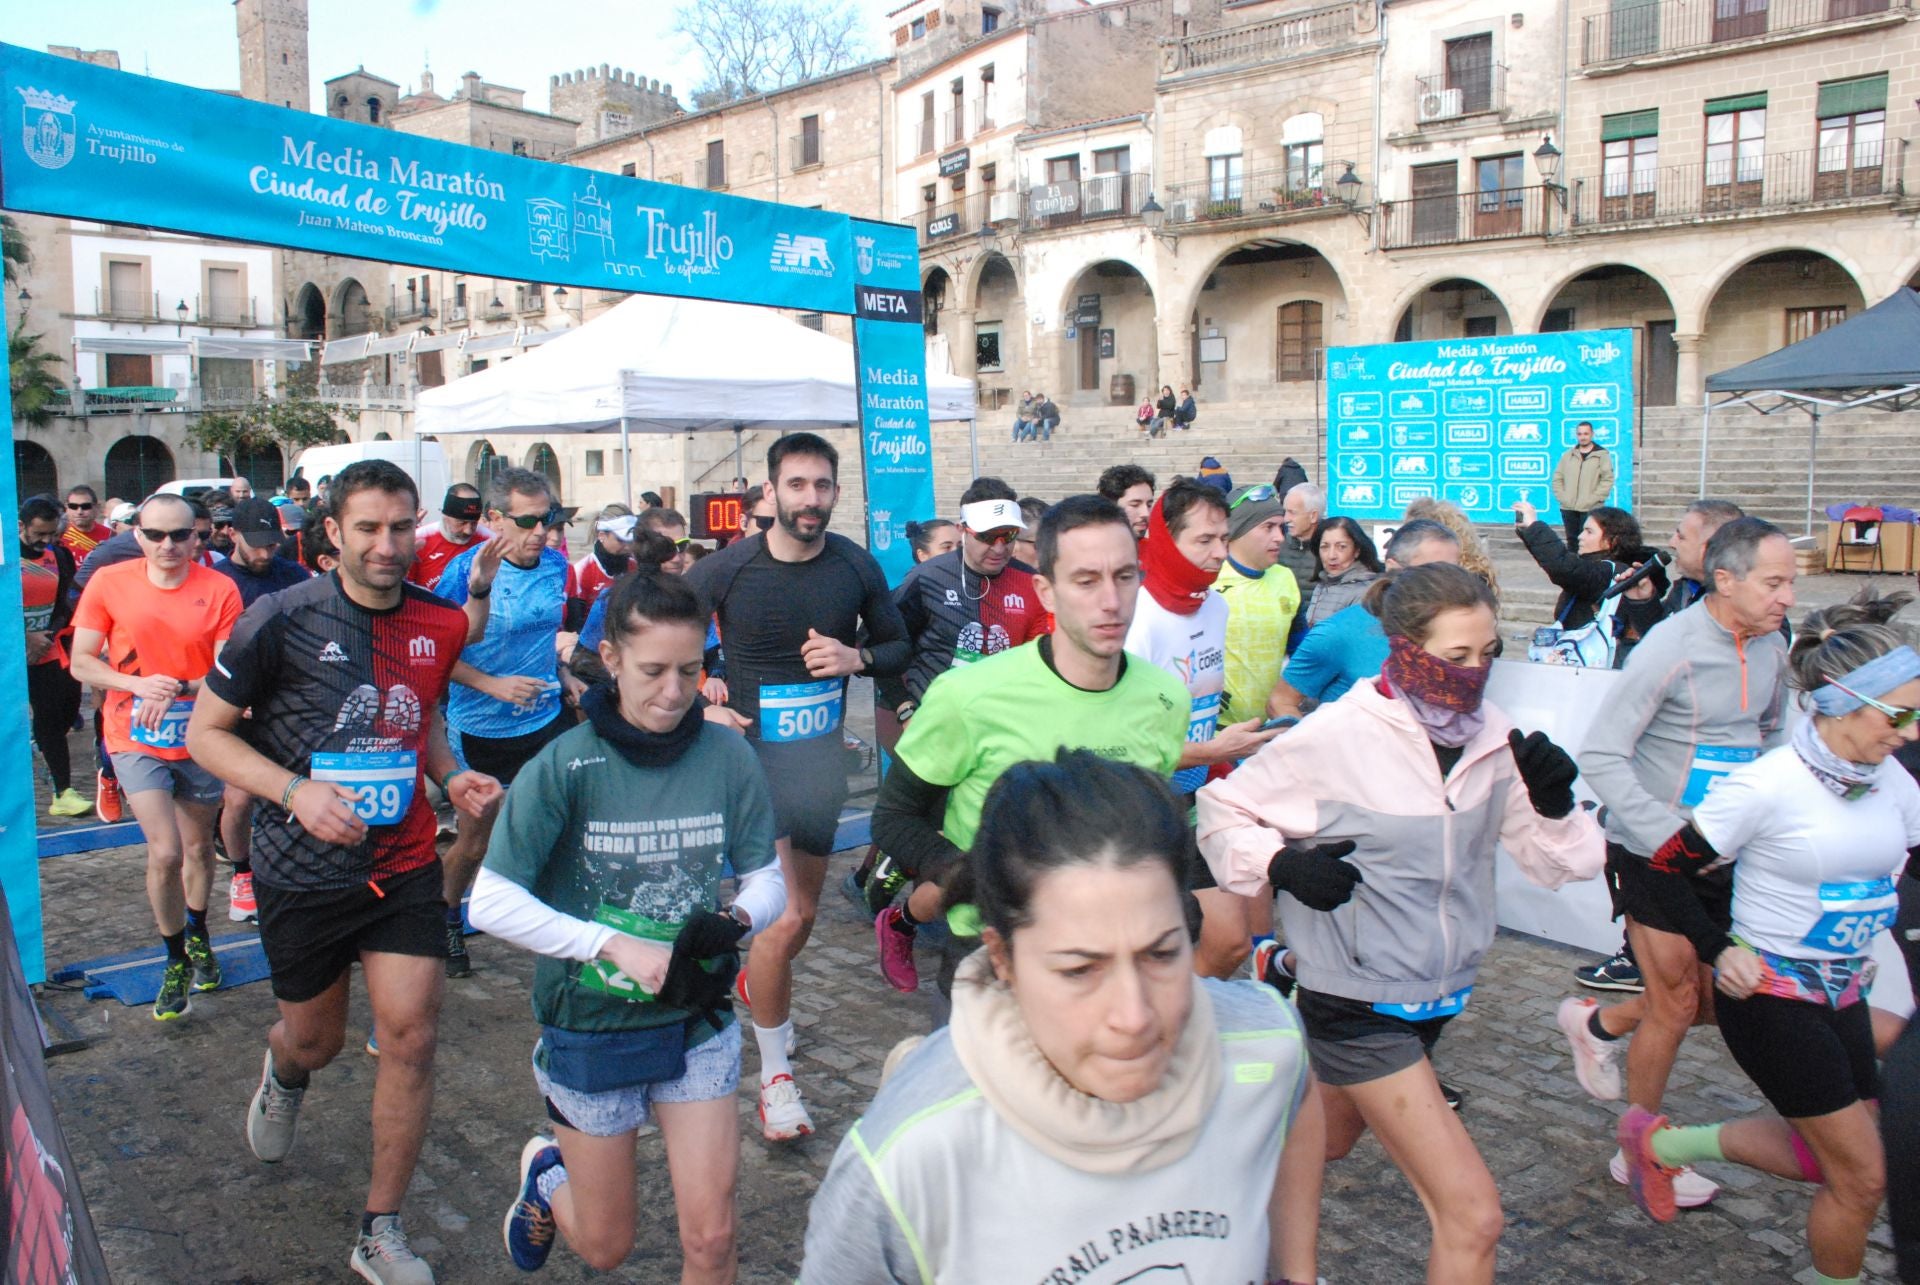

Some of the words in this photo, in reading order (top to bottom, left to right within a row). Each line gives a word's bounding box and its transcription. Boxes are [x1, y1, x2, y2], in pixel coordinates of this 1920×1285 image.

[88, 123, 169, 149] Ayuntamiento
[171, 142, 184, 152] de
[86, 138, 157, 164] Trujillo
[282, 136, 380, 181] Media
[390, 157, 506, 202] Maratón
[249, 165, 351, 209] Ciudad
[355, 188, 392, 215] de
[396, 190, 487, 236] Trujillo
[297, 211, 332, 227] Juan
[336, 216, 384, 237] Mateos
[387, 225, 444, 247] Broncano
[636, 206, 734, 270] Trujillo
[664, 256, 676, 275] te
[863, 293, 909, 314] META
[1438, 344, 1478, 359] Media
[1481, 341, 1538, 357] Maratón
[1577, 341, 1621, 363] Trujillo
[868, 367, 920, 386] Media
[1387, 360, 1455, 381] Ciudad
[1458, 359, 1487, 377] de
[1490, 355, 1567, 382] Trujillo
[866, 393, 925, 411] Maratón
[1510, 395, 1540, 405] HABLA
[874, 416, 904, 429] Ciudad
[1453, 428, 1482, 438] HABLA
[868, 431, 926, 464] Trujillo
[1509, 461, 1539, 471] HABLA
[778, 705, 829, 737] 500
[609, 820, 656, 834] CARRERA
[656, 818, 677, 832] POR
[678, 811, 724, 829] MONTAÑA
[639, 834, 658, 854] DE
[660, 833, 680, 851] LA
[683, 826, 726, 849] MOSC
[1108, 1209, 1231, 1255] PAJARERO
